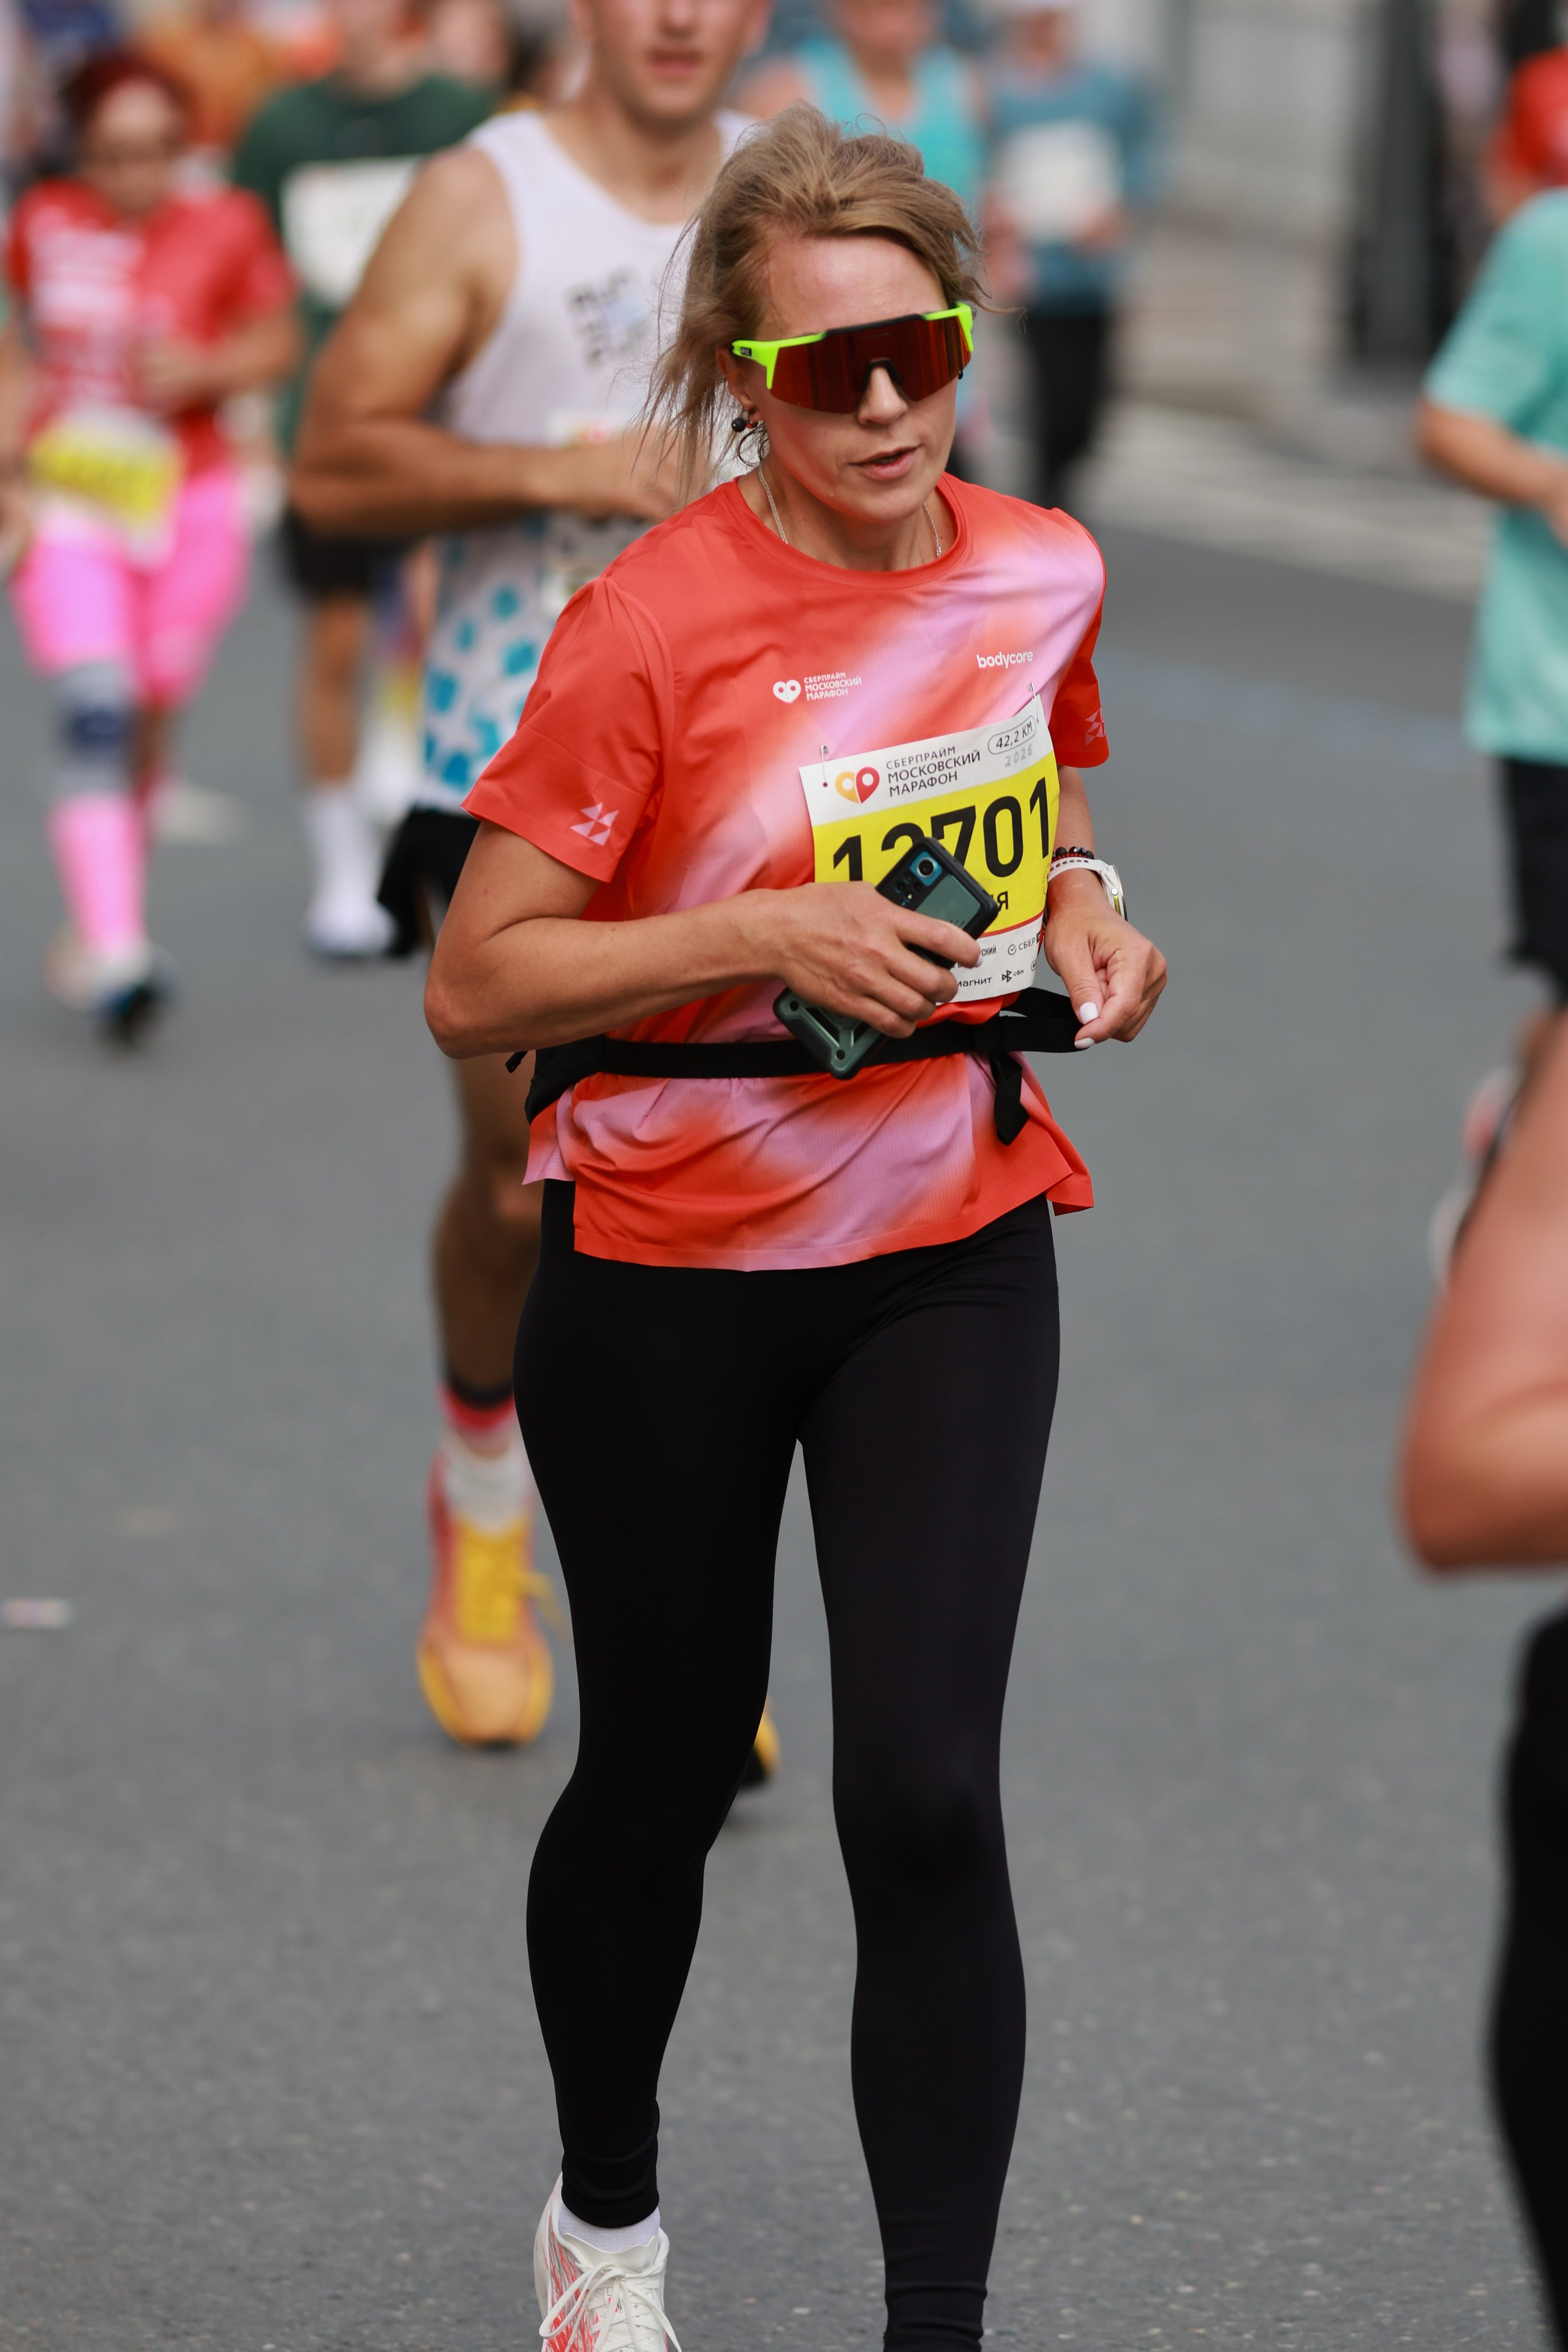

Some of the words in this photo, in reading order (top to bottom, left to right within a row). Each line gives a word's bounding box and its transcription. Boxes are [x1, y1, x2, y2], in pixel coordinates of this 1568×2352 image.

[976, 651, 1033, 669] bodycore
[804, 672, 846, 684] СБЕРПРАЙМ
[805, 676, 862, 693] МОСКОВСКИЙ
[806, 688, 848, 701] МАРАФОН
[996, 730, 1019, 748] 42,2
[1022, 720, 1033, 739] КМ
[886, 745, 956, 770] СБЕРПРАЙМ
[1005, 743, 1033, 767] 2026
[888, 749, 981, 784] МОСКОВСКИЙ
[889, 771, 957, 797] МАРАФОН
[980, 945, 997, 957] СКИЙ
[1019, 937, 1036, 950] СБЕР
